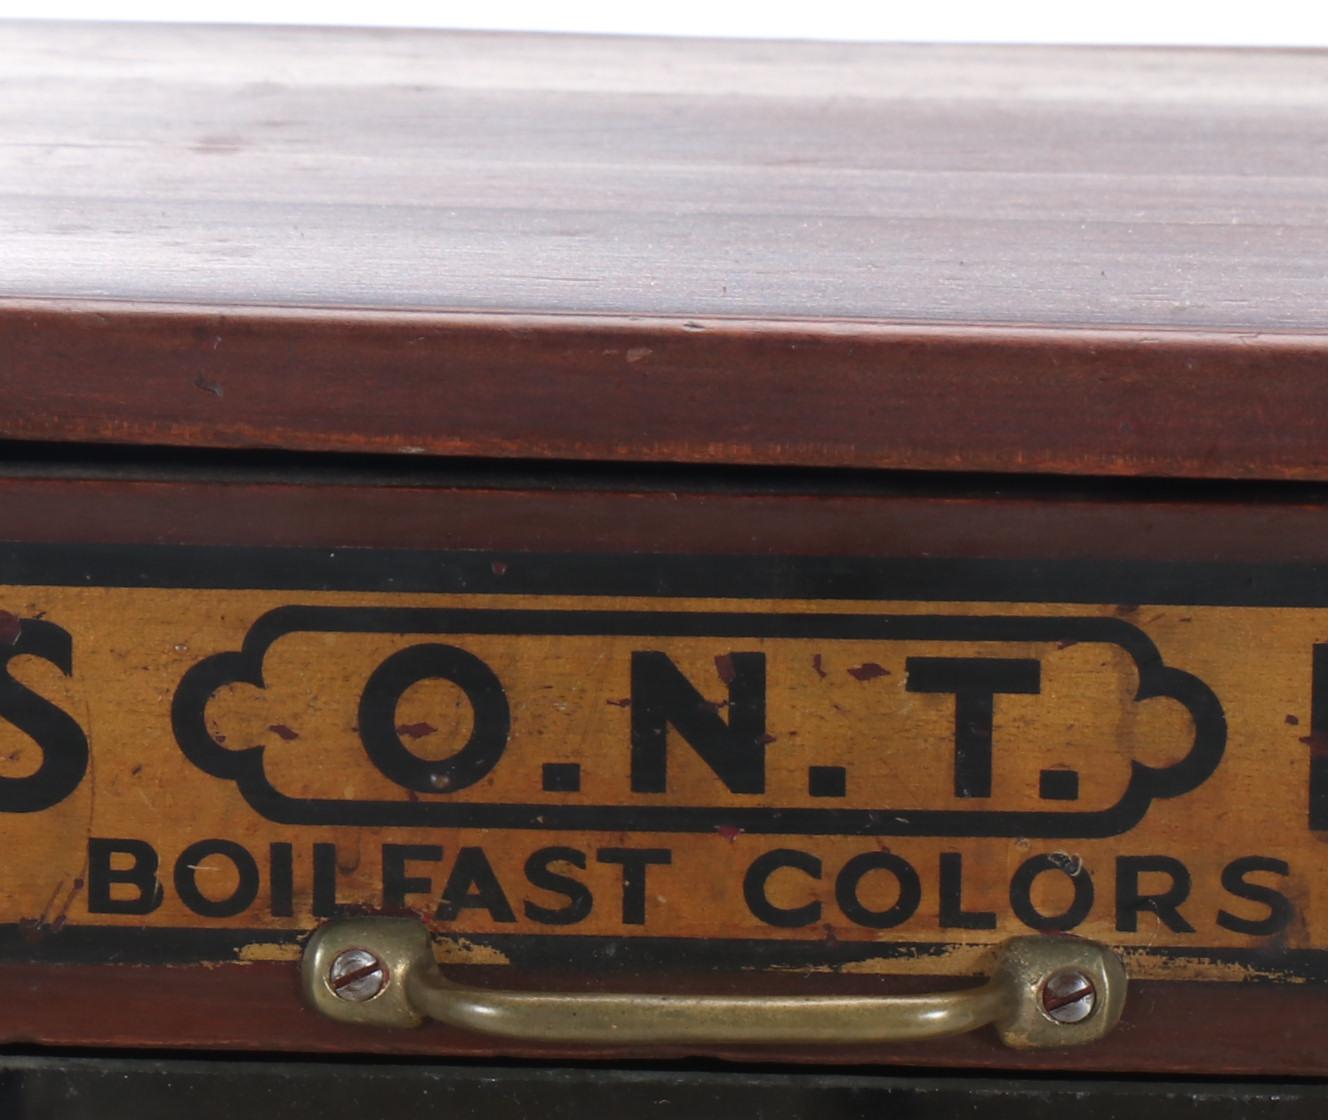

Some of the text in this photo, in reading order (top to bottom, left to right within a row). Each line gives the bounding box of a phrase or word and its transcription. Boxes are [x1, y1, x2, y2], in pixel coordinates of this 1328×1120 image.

[358, 643, 1079, 800] O.N.T.
[87, 838, 1296, 936] BOILFAST COLORS
